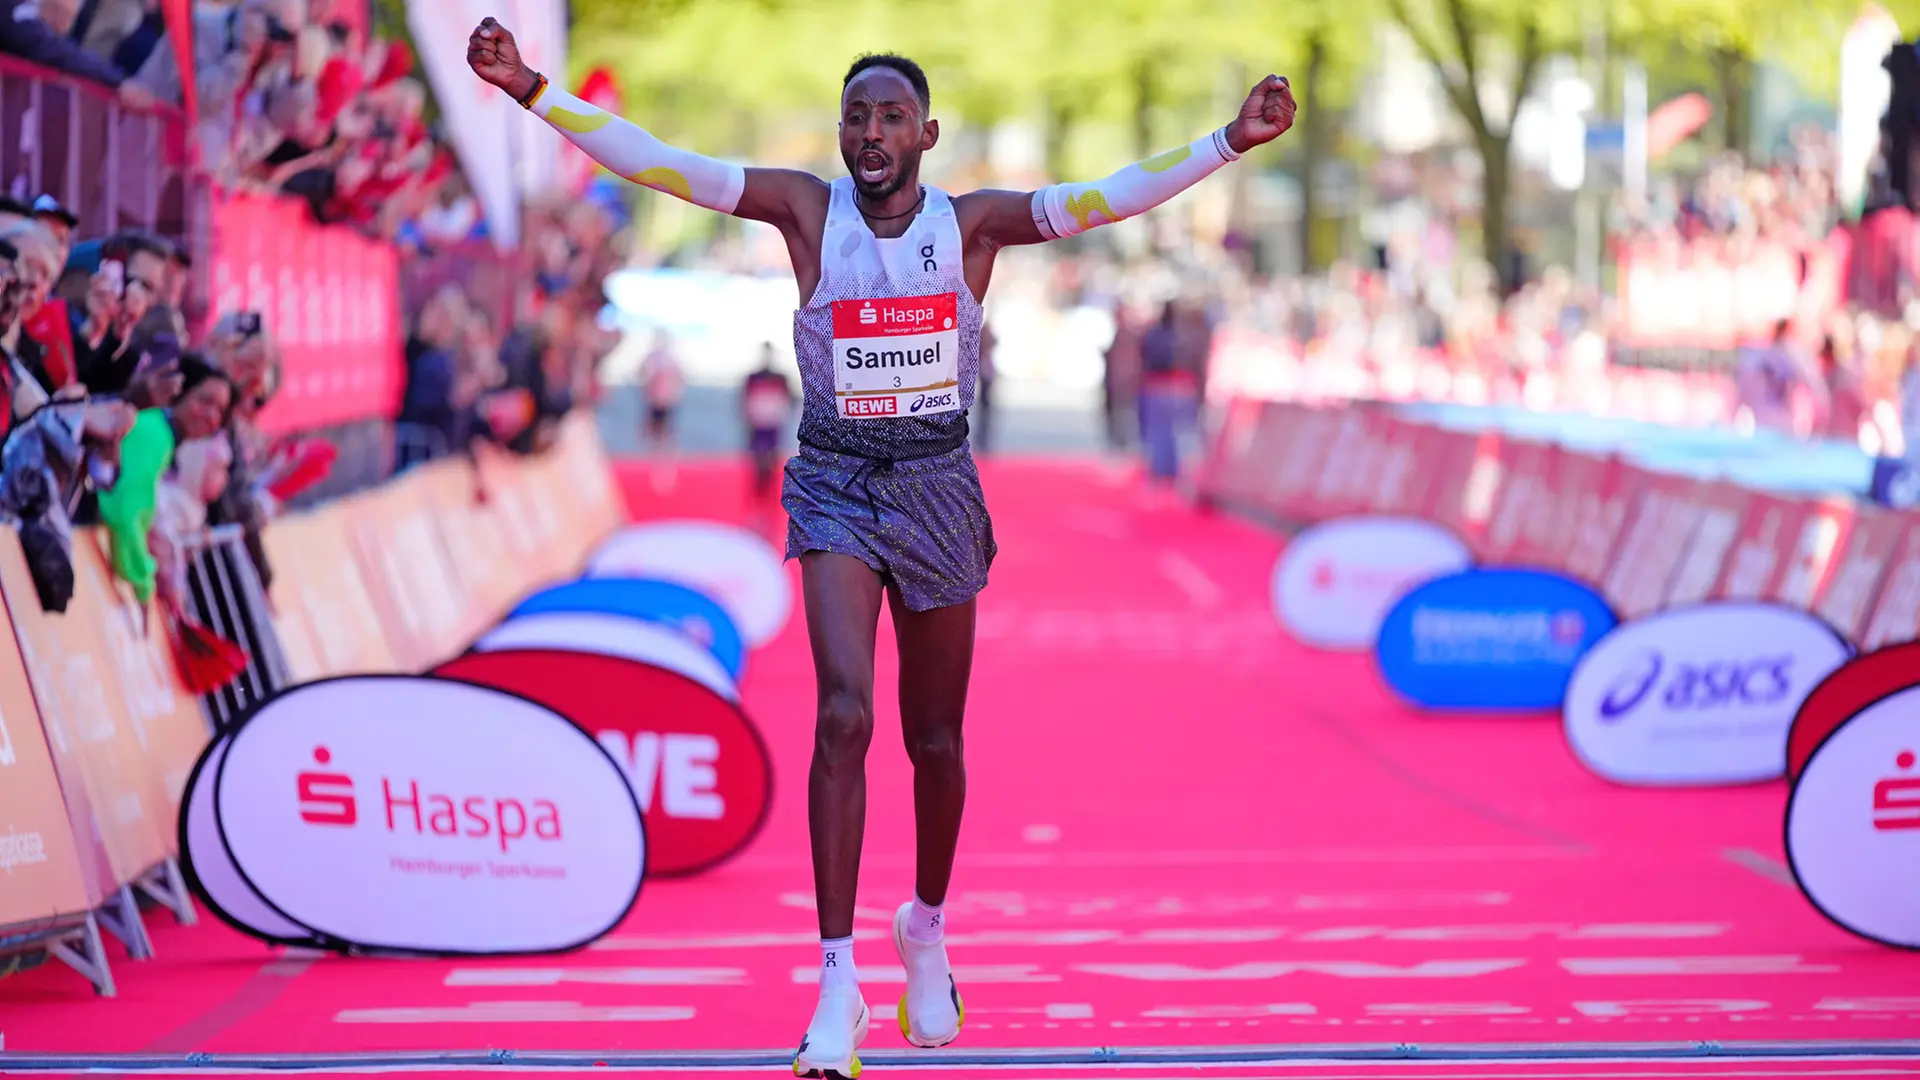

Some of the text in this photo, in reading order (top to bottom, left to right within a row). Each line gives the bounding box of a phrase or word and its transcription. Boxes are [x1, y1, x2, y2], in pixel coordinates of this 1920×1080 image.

[883, 307, 935, 325] Haspa
[845, 341, 941, 370] Samuel
[893, 376, 902, 388] 3
[848, 399, 895, 415] REWE
[925, 393, 952, 408] asics
[1664, 657, 1793, 708] asics
[381, 776, 563, 852] Haspa
